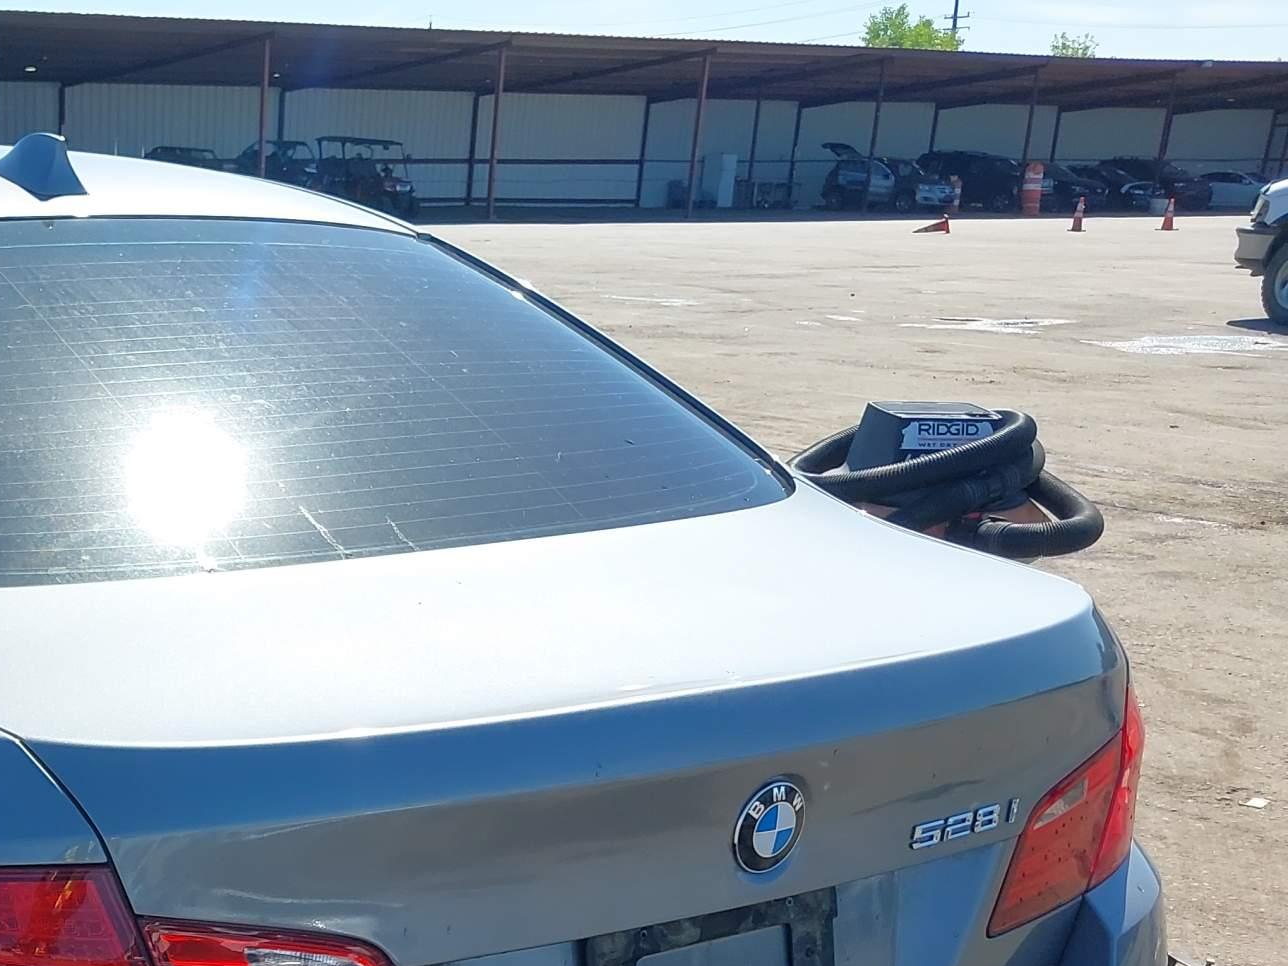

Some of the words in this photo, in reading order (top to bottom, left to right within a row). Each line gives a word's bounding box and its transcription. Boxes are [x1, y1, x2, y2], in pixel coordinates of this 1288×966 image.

[918, 423, 980, 436] RIDGID
[748, 786, 804, 820] BMW
[911, 798, 1020, 850] 528i
